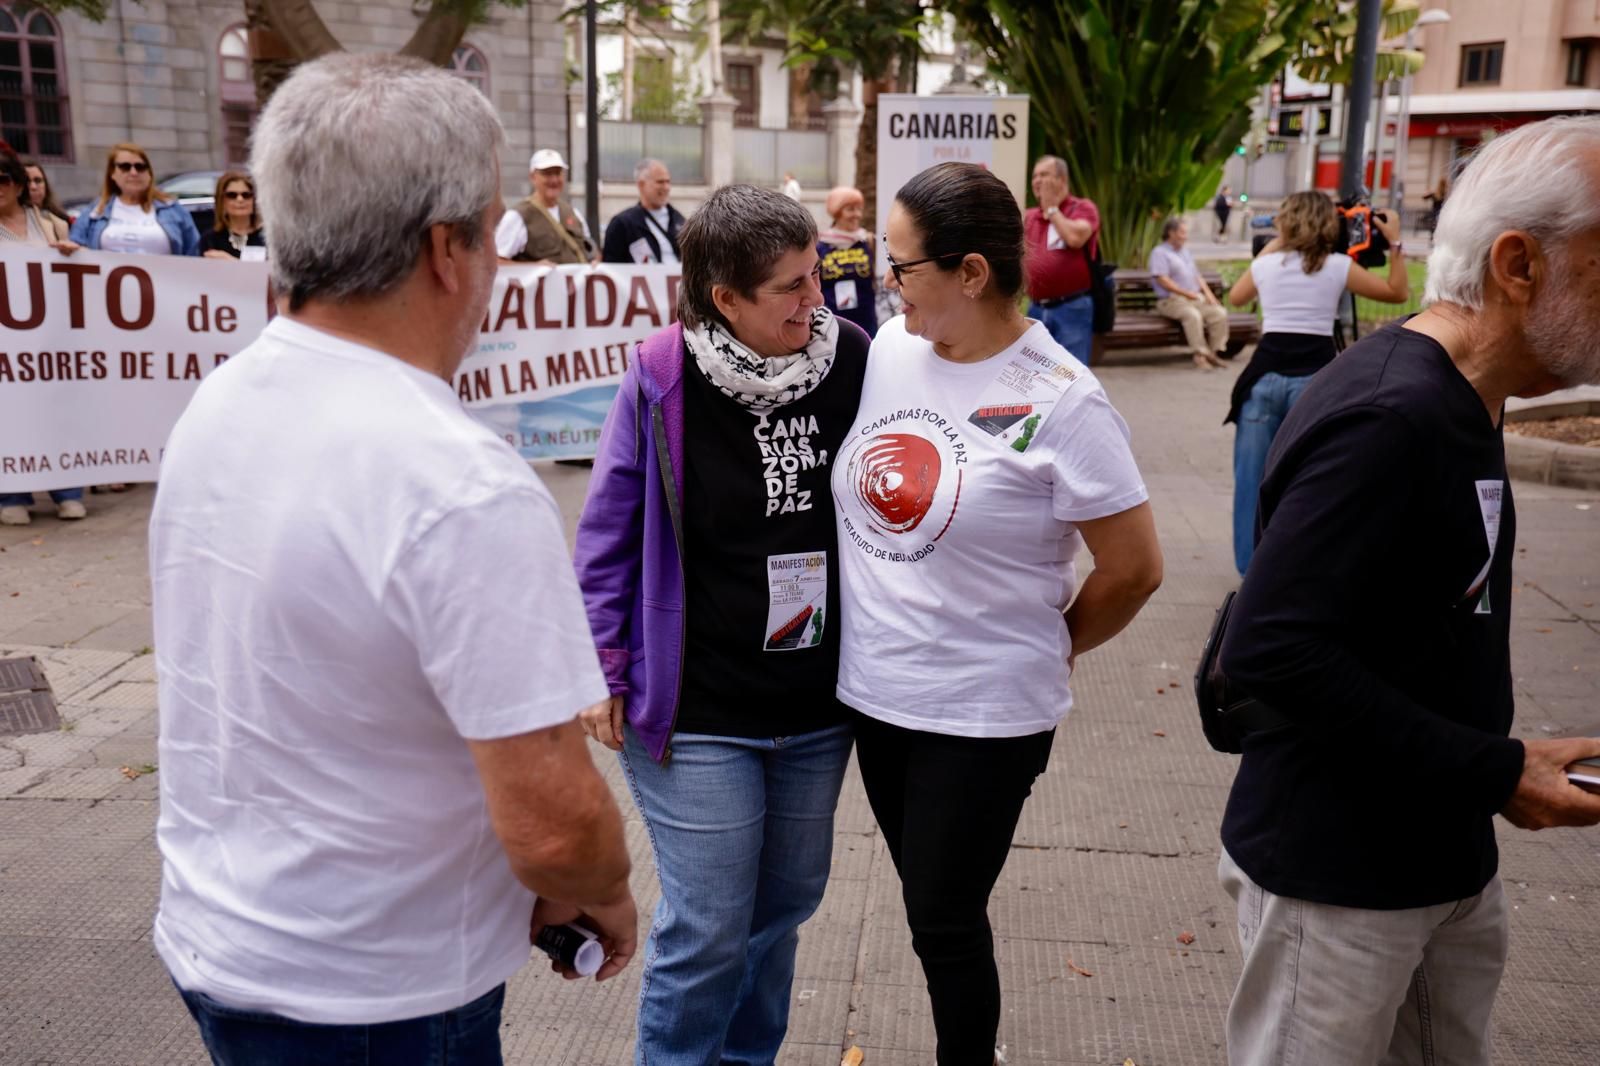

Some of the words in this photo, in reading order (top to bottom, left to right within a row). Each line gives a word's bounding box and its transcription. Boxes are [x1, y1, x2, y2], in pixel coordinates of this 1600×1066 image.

[889, 113, 1017, 139] CANARIAS
[187, 294, 237, 333] de
[121, 352, 154, 380] DE
[168, 353, 202, 381] LA
[451, 367, 492, 402] AN
[501, 360, 537, 395] LA
[546, 341, 643, 387] MALET
[521, 431, 541, 447] LA
[754, 415, 820, 441] CANA
[861, 408, 921, 435] CANARIAS
[922, 409, 946, 429] POR
[943, 427, 957, 442] LA
[953, 443, 967, 465] PAZ
[758, 437, 813, 457] RIAS
[2, 455, 52, 474] RMA
[59, 449, 150, 470] CANARIA
[762, 449, 827, 479] ZONA
[766, 474, 798, 498] DE
[766, 490, 812, 517] PAZ
[843, 517, 874, 554] ESTATUTO
[875, 548, 887, 560] DE
[889, 544, 935, 563] NEUALIDAD
